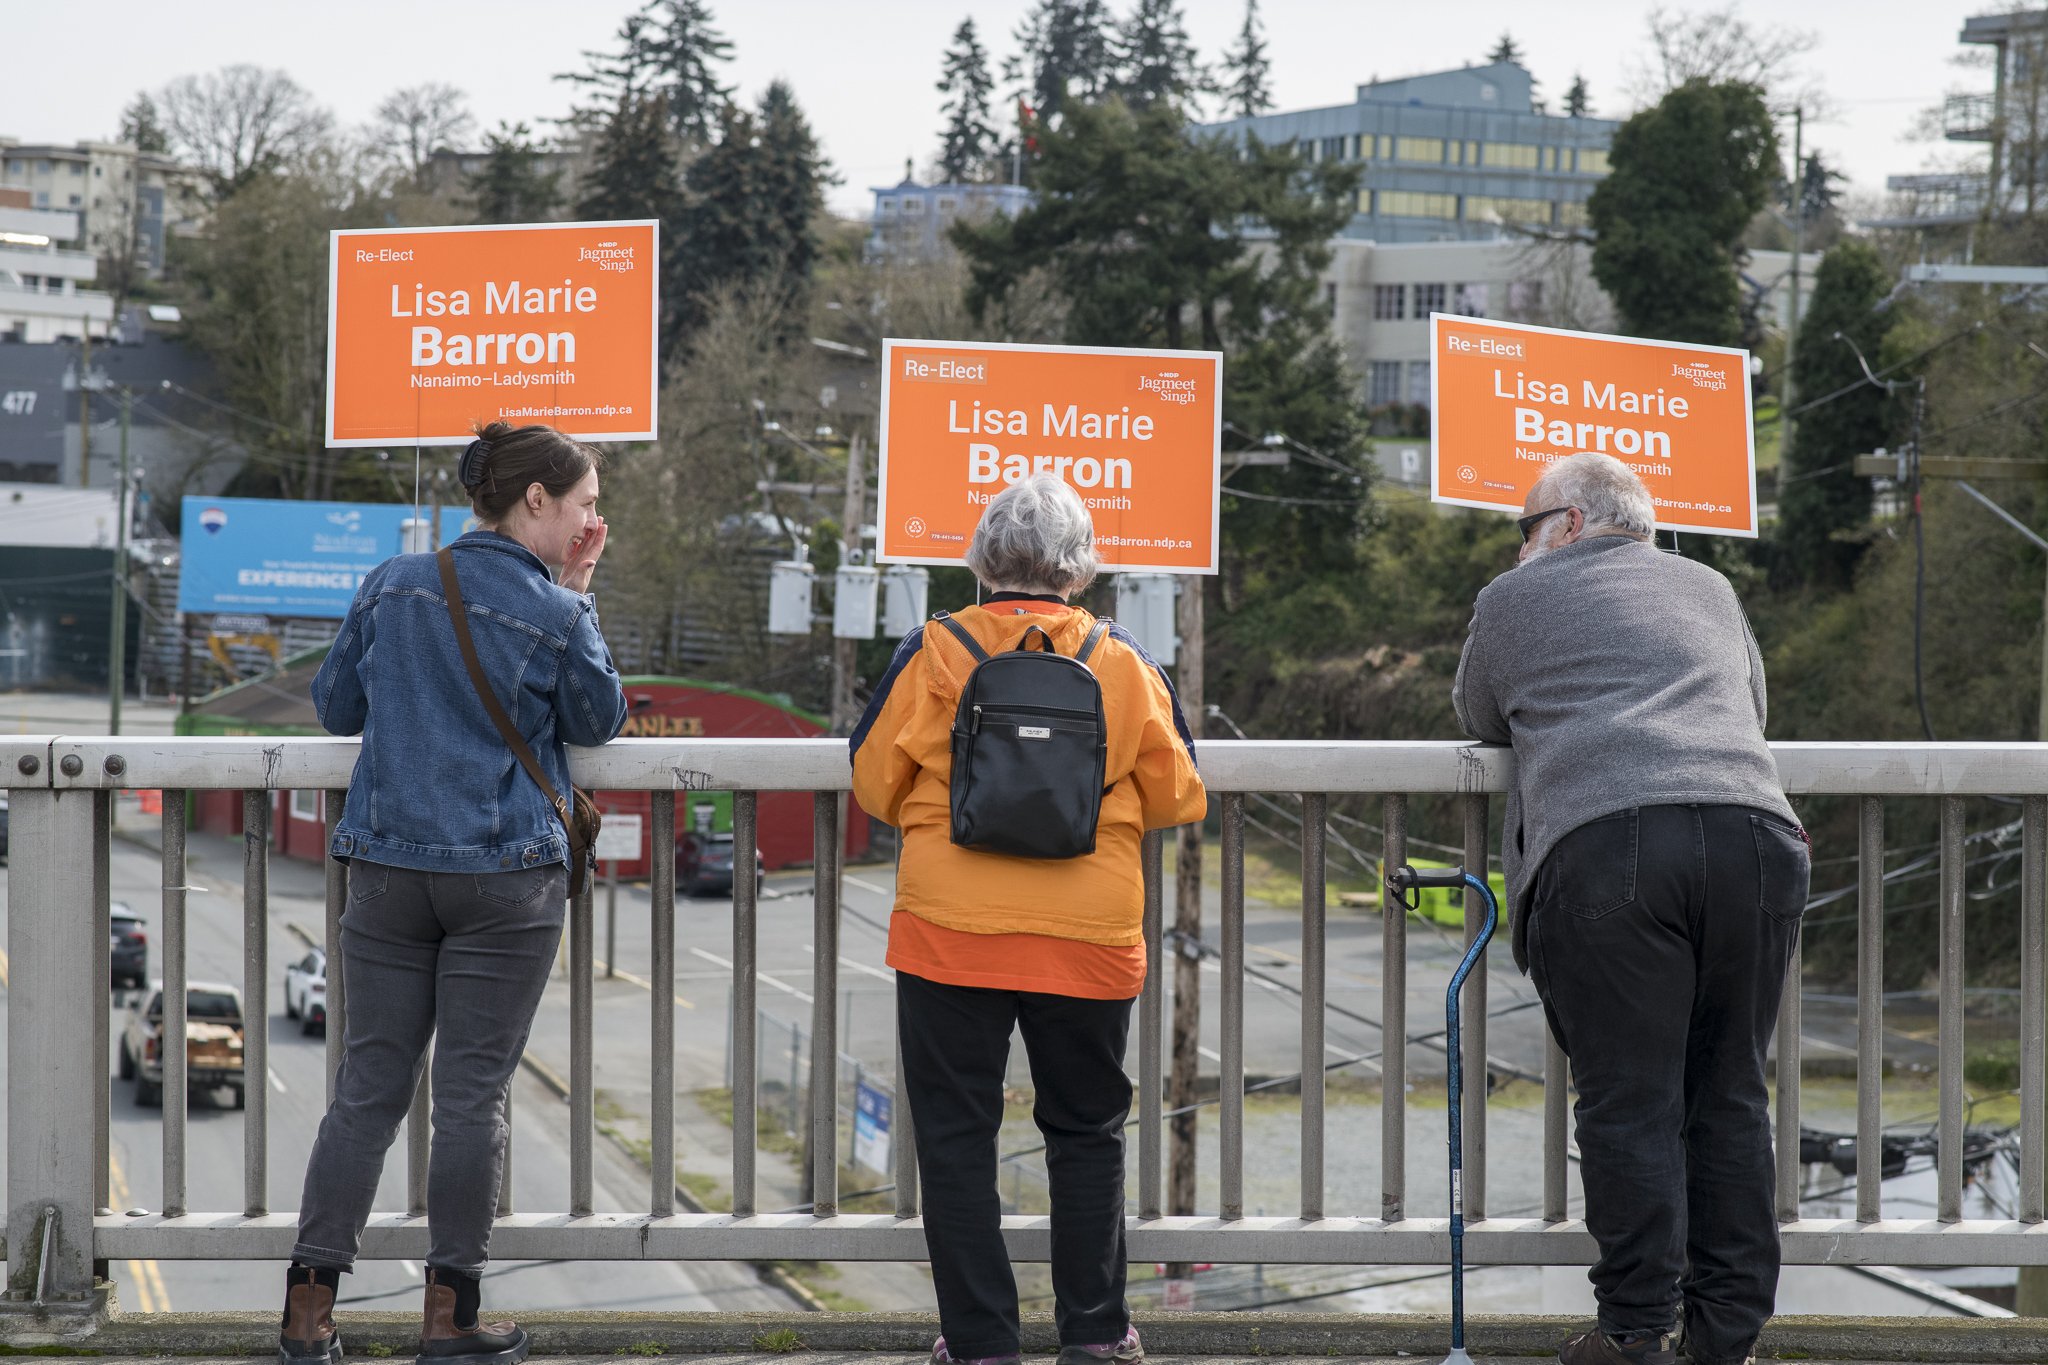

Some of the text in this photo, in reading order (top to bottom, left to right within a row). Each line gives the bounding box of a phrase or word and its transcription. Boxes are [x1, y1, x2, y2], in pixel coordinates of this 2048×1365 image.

[356, 248, 414, 263] Re-Elect
[577, 246, 634, 262] Jagmeet
[599, 259, 634, 273] Singh
[391, 278, 597, 318] Lisa Marie
[411, 325, 576, 367] Barron
[1448, 335, 1523, 358] Re-Elect
[905, 359, 984, 380] Re-Elect
[1671, 363, 1726, 380] Jagmeet
[1137, 375, 1196, 392] Jagmeet
[1693, 377, 1727, 391] Singh
[1160, 390, 1196, 405] Singh
[1494, 369, 1690, 419] Lisa Marie
[499, 405, 633, 417] LisaMarieBarron.ndp.ca
[949, 400, 1154, 441] Lisa Marie
[1515, 407, 1672, 459] Barron
[968, 443, 1132, 489] Barron
